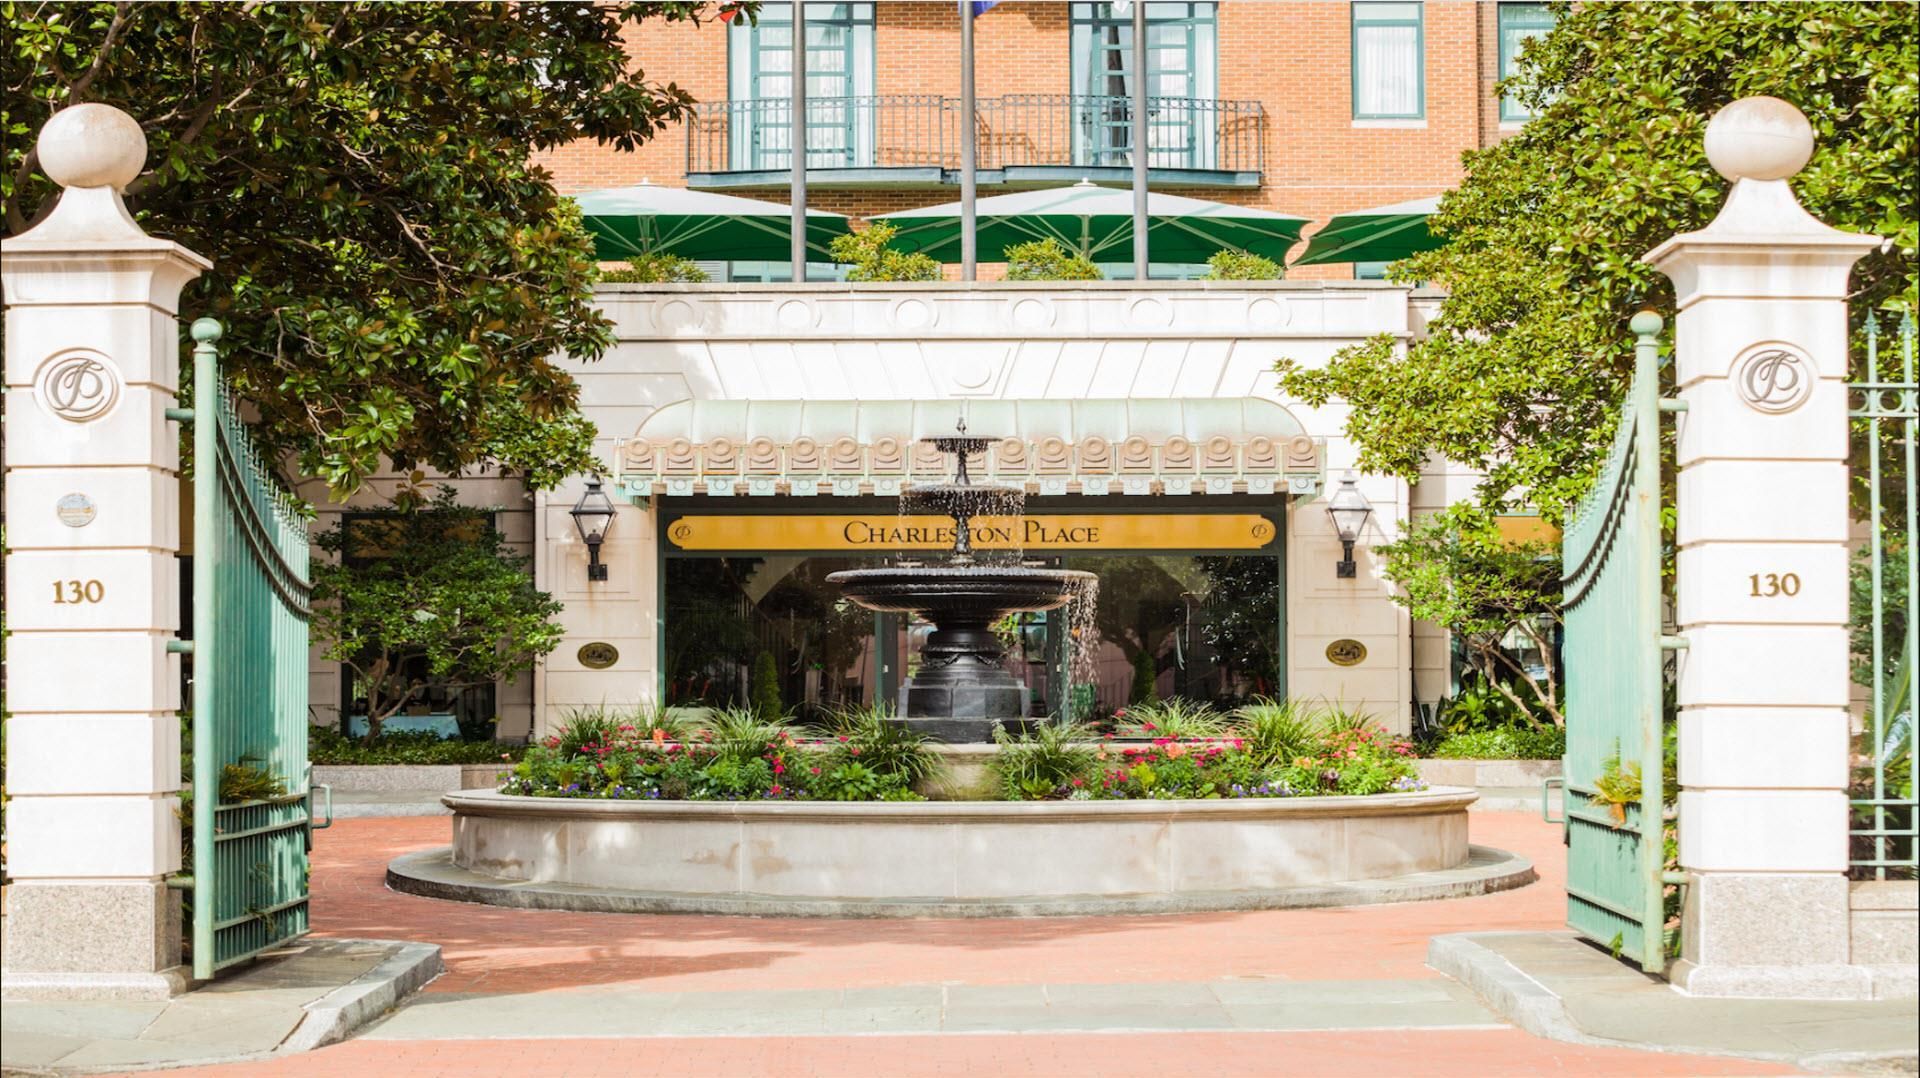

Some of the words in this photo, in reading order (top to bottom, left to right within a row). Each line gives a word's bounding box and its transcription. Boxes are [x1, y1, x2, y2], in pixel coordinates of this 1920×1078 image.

[843, 520, 1011, 544] CHARLESTON
[1023, 520, 1100, 543] PLACE
[52, 579, 105, 604] 130
[1749, 572, 1802, 597] 130
